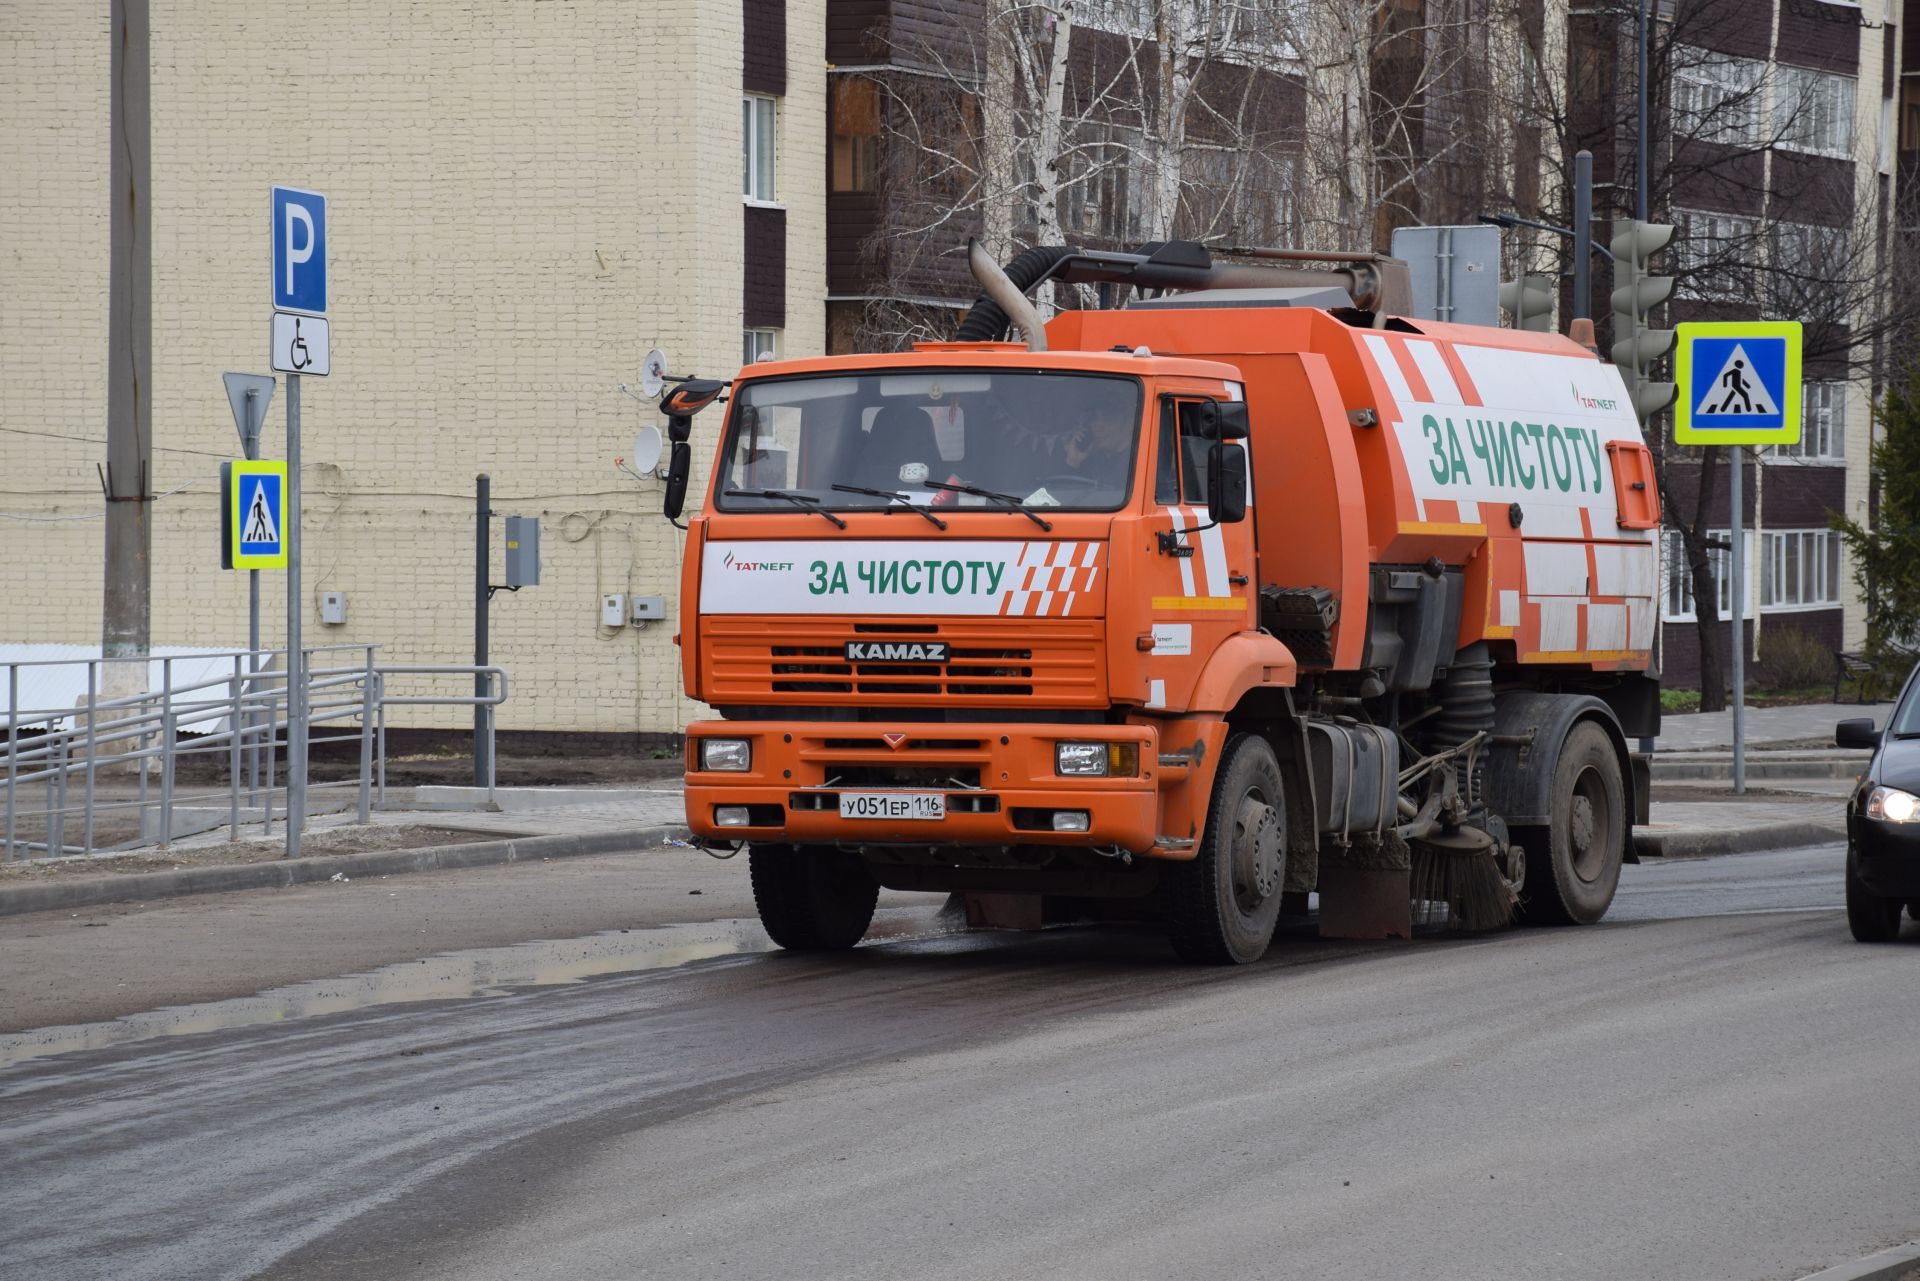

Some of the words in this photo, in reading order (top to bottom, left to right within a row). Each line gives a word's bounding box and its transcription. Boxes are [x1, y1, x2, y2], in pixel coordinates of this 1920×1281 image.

[286, 202, 315, 296] P
[1580, 397, 1618, 411] TATNEFT
[1422, 414, 1471, 485] ЗА
[1466, 418, 1602, 494] ЧИСТОТУ
[735, 562, 794, 571] TATNEFT
[808, 560, 849, 595] ЗА
[857, 560, 1006, 595] ЧИСТОТУ
[848, 643, 945, 660] KAMAZ
[914, 797, 939, 812] 116
